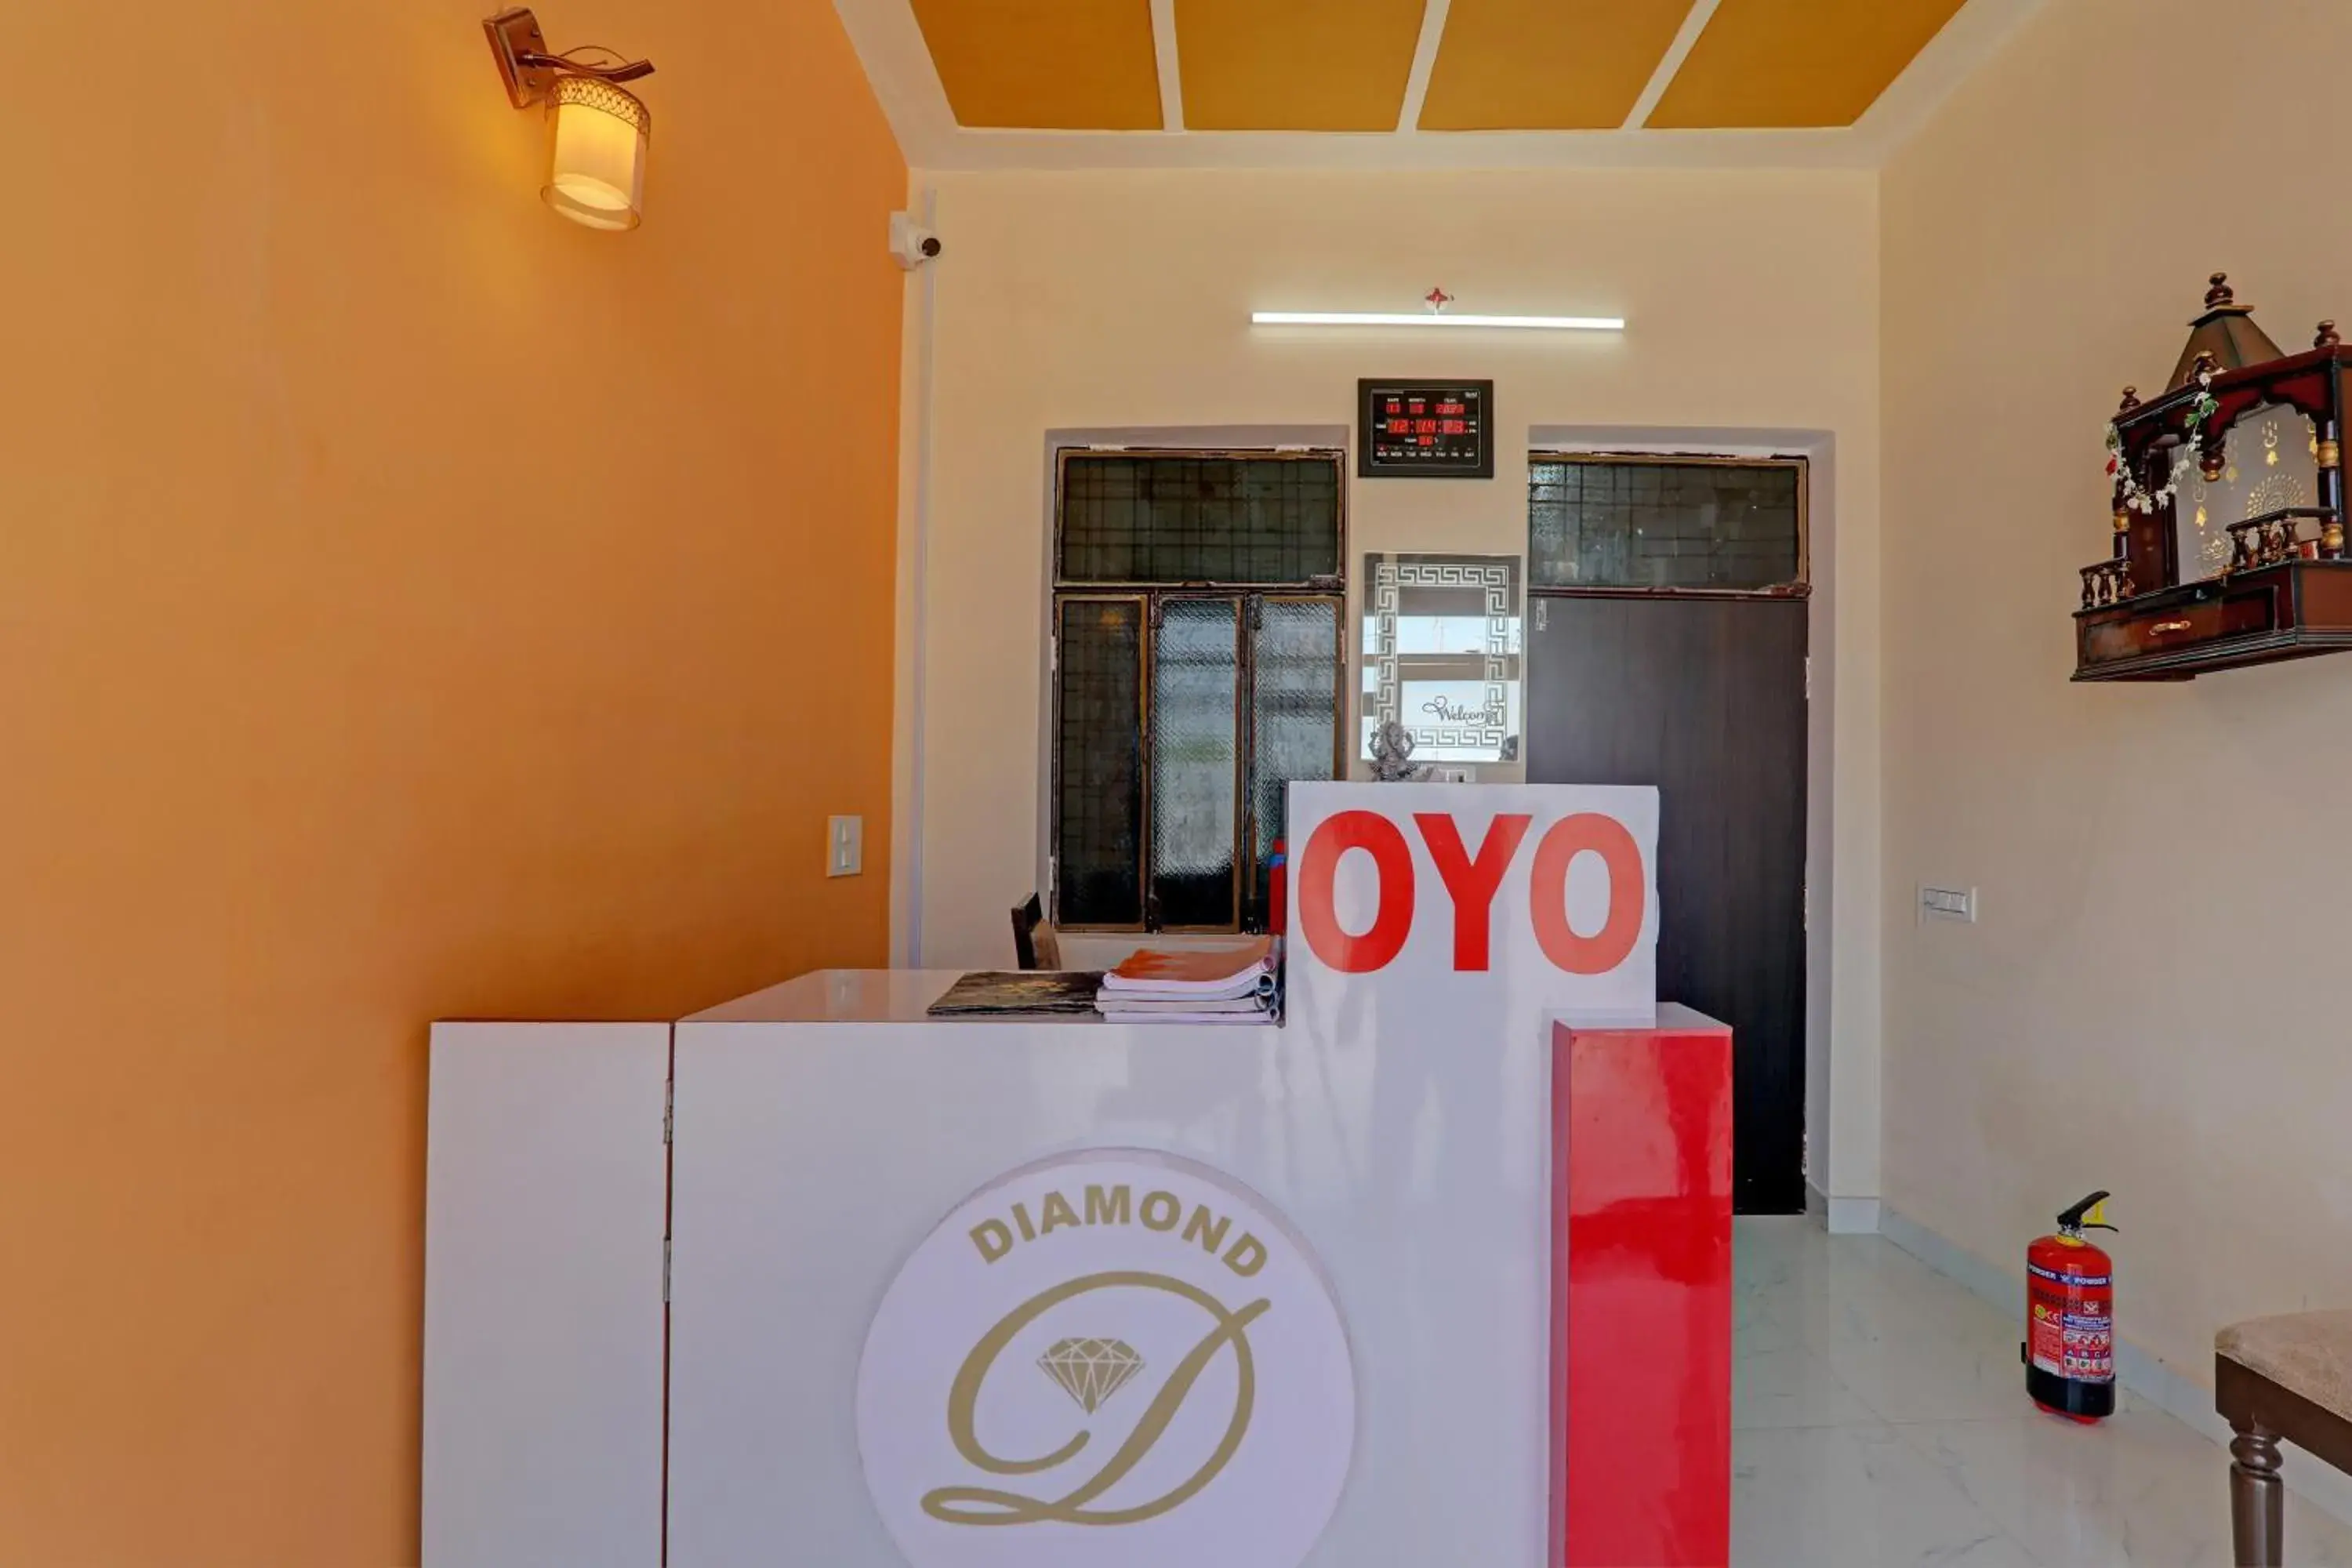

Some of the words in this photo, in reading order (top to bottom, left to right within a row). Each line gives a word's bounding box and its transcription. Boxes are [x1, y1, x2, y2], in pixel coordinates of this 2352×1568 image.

[1298, 810, 1645, 975] OYO
[968, 1185, 1269, 1278] DIAMOND
[2074, 1276, 2107, 1286] POWDER
